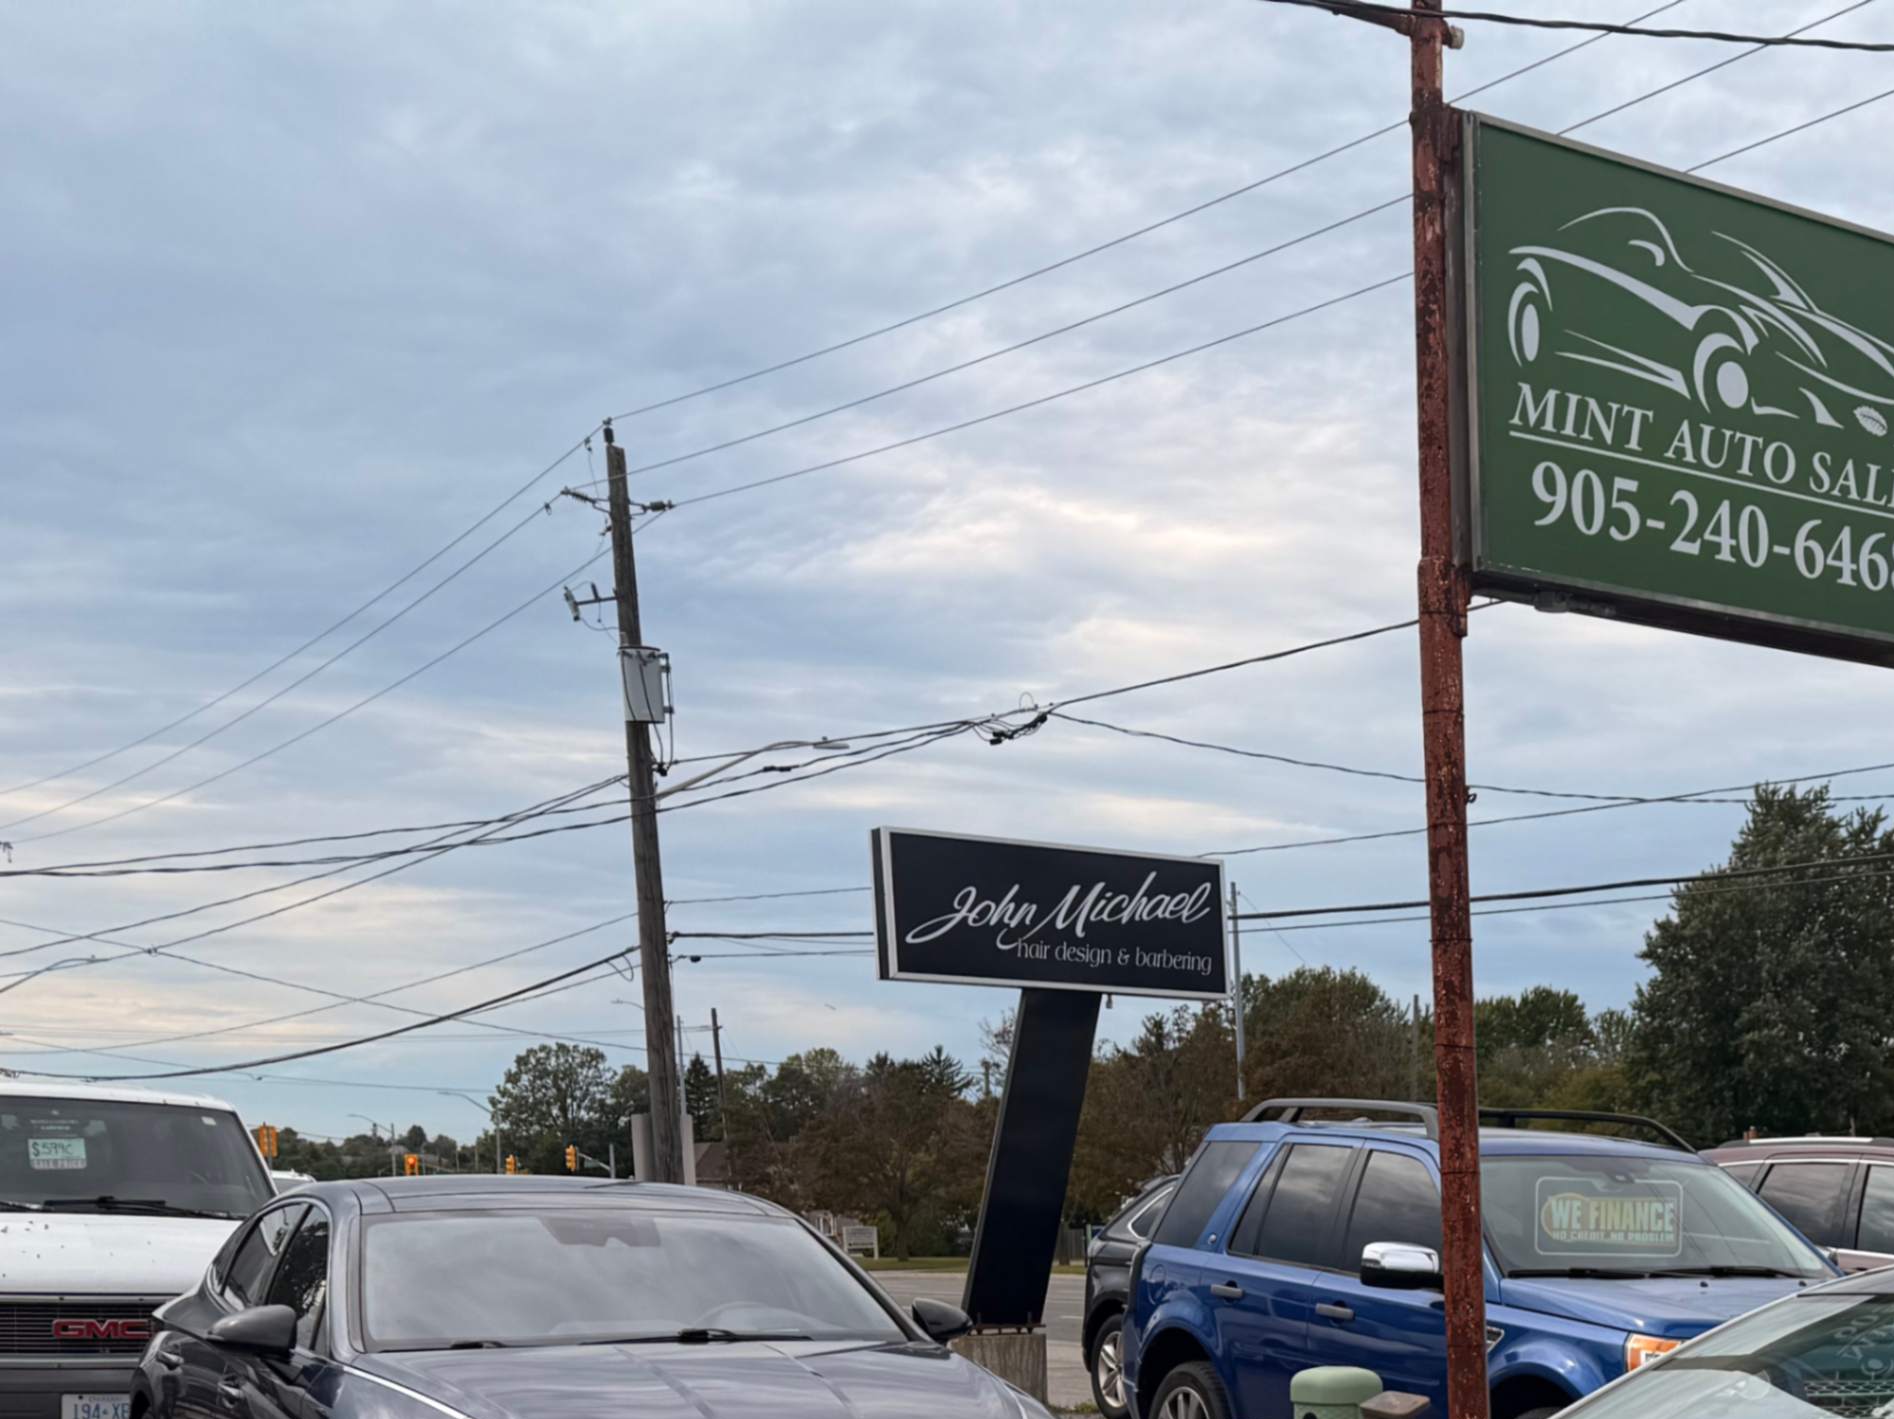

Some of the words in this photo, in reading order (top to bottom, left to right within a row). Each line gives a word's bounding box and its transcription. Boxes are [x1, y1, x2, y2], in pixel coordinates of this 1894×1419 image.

[1509, 382, 1654, 451] MINT
[1663, 419, 1797, 485] AUTO
[905, 883, 1038, 944] John
[1000, 871, 1212, 948] Michael
[1016, 937, 1050, 960] hair
[1054, 941, 1112, 968] design
[1117, 947, 1130, 966] &
[1135, 946, 1212, 976] barbering
[1551, 1199, 1582, 1230] WE
[1589, 1200, 1674, 1232] FINANCE
[52, 1318, 152, 1339] GMC
[111, 1402, 129, 1419] XE
